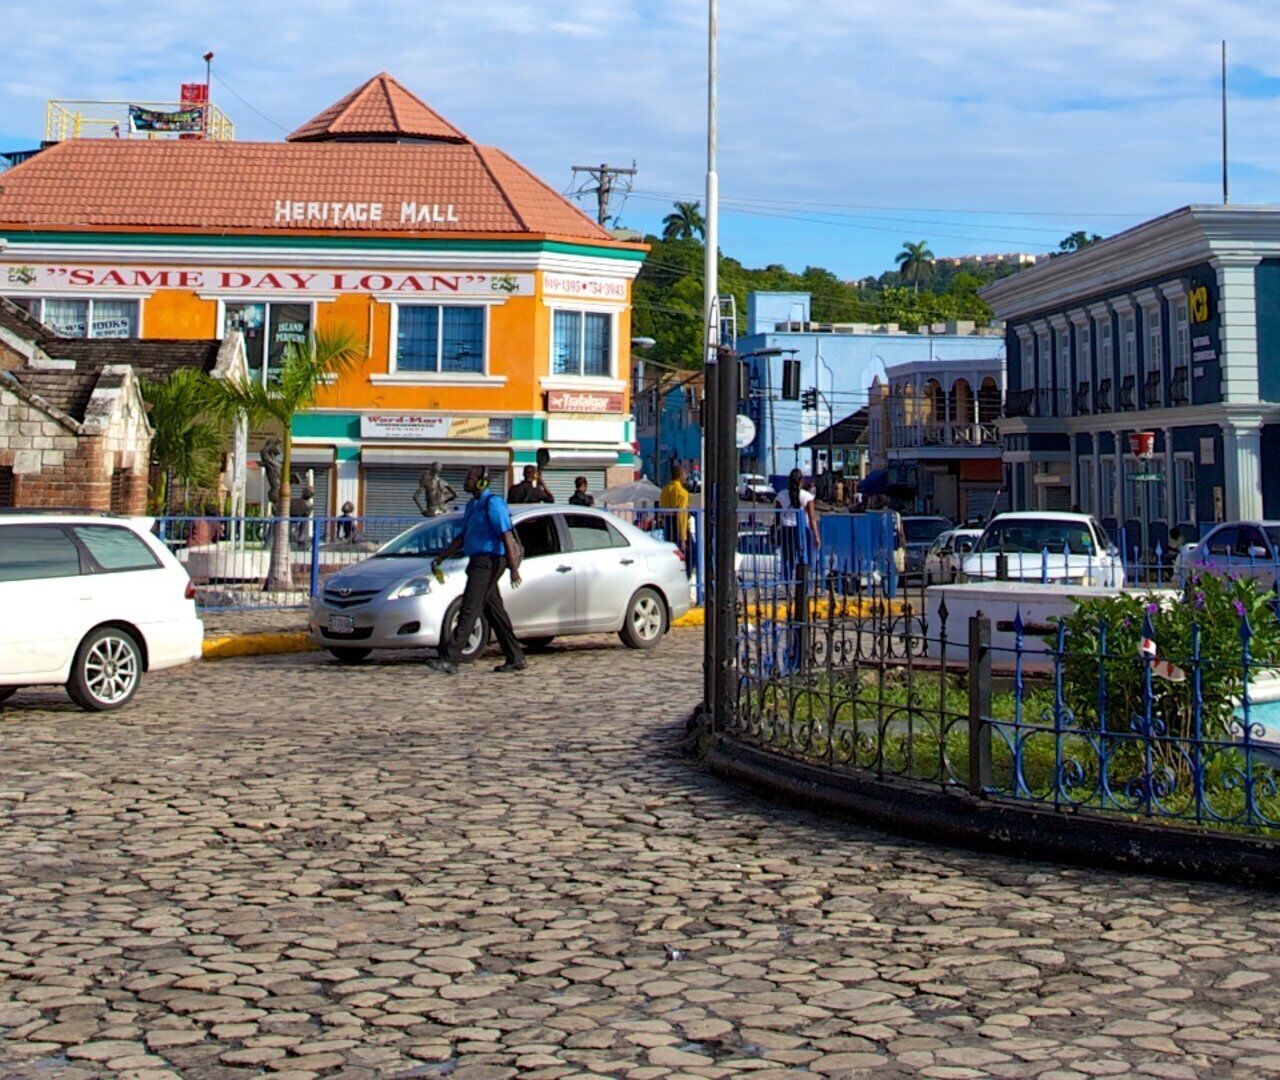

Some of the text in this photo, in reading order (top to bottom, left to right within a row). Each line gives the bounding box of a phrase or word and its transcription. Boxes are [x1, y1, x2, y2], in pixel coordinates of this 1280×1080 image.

[275, 200, 459, 225] HERITAGE MALL
[217, 271, 320, 289] DAY
[278, 322, 304, 332] ISLAND
